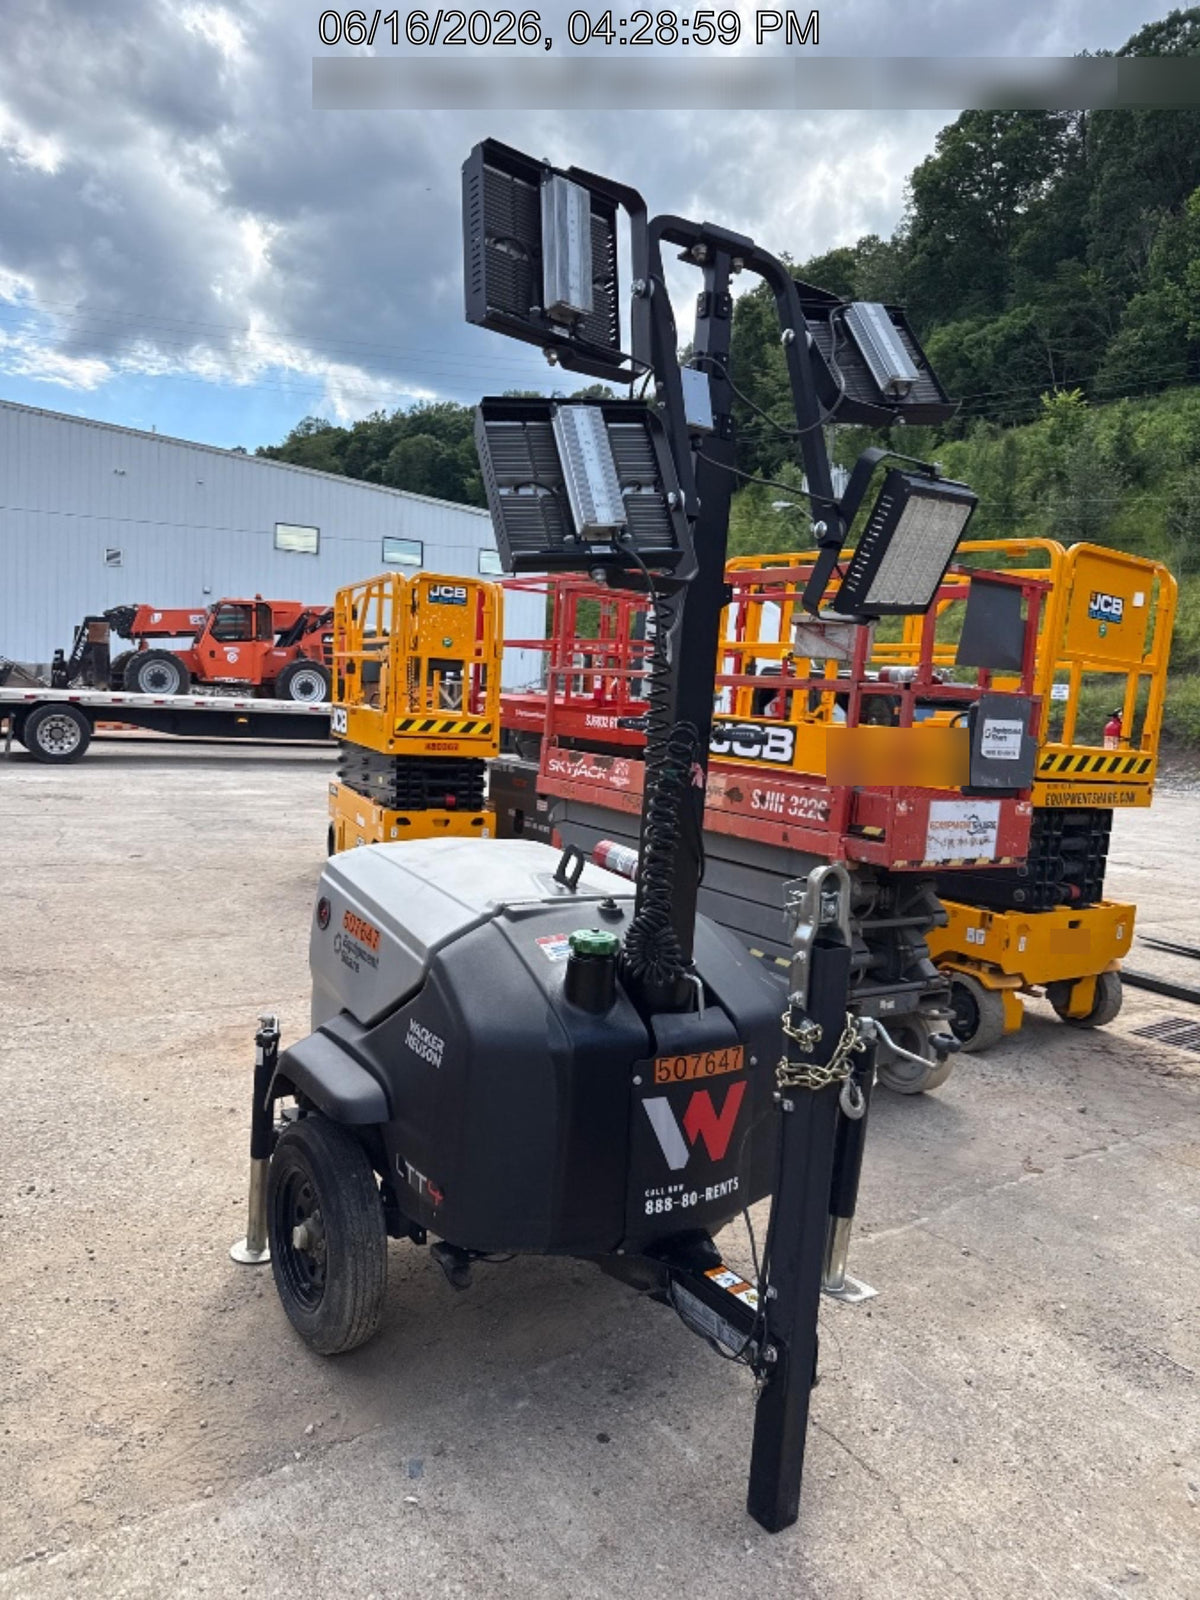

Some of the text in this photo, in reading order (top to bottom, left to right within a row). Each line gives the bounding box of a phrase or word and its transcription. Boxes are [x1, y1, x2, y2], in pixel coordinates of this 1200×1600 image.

[430, 585, 466, 599] JCB
[1090, 593, 1123, 616] JCB
[548, 757, 608, 780] SKYJACK
[405, 1032, 442, 1068] NEUSON
[410, 1018, 445, 1055] WACKER
[657, 1046, 742, 1082] 507647
[395, 1152, 444, 1207] LTT4
[644, 1183, 685, 1197] CALL NOW
[644, 1176, 740, 1216] 888-80-RENTS
